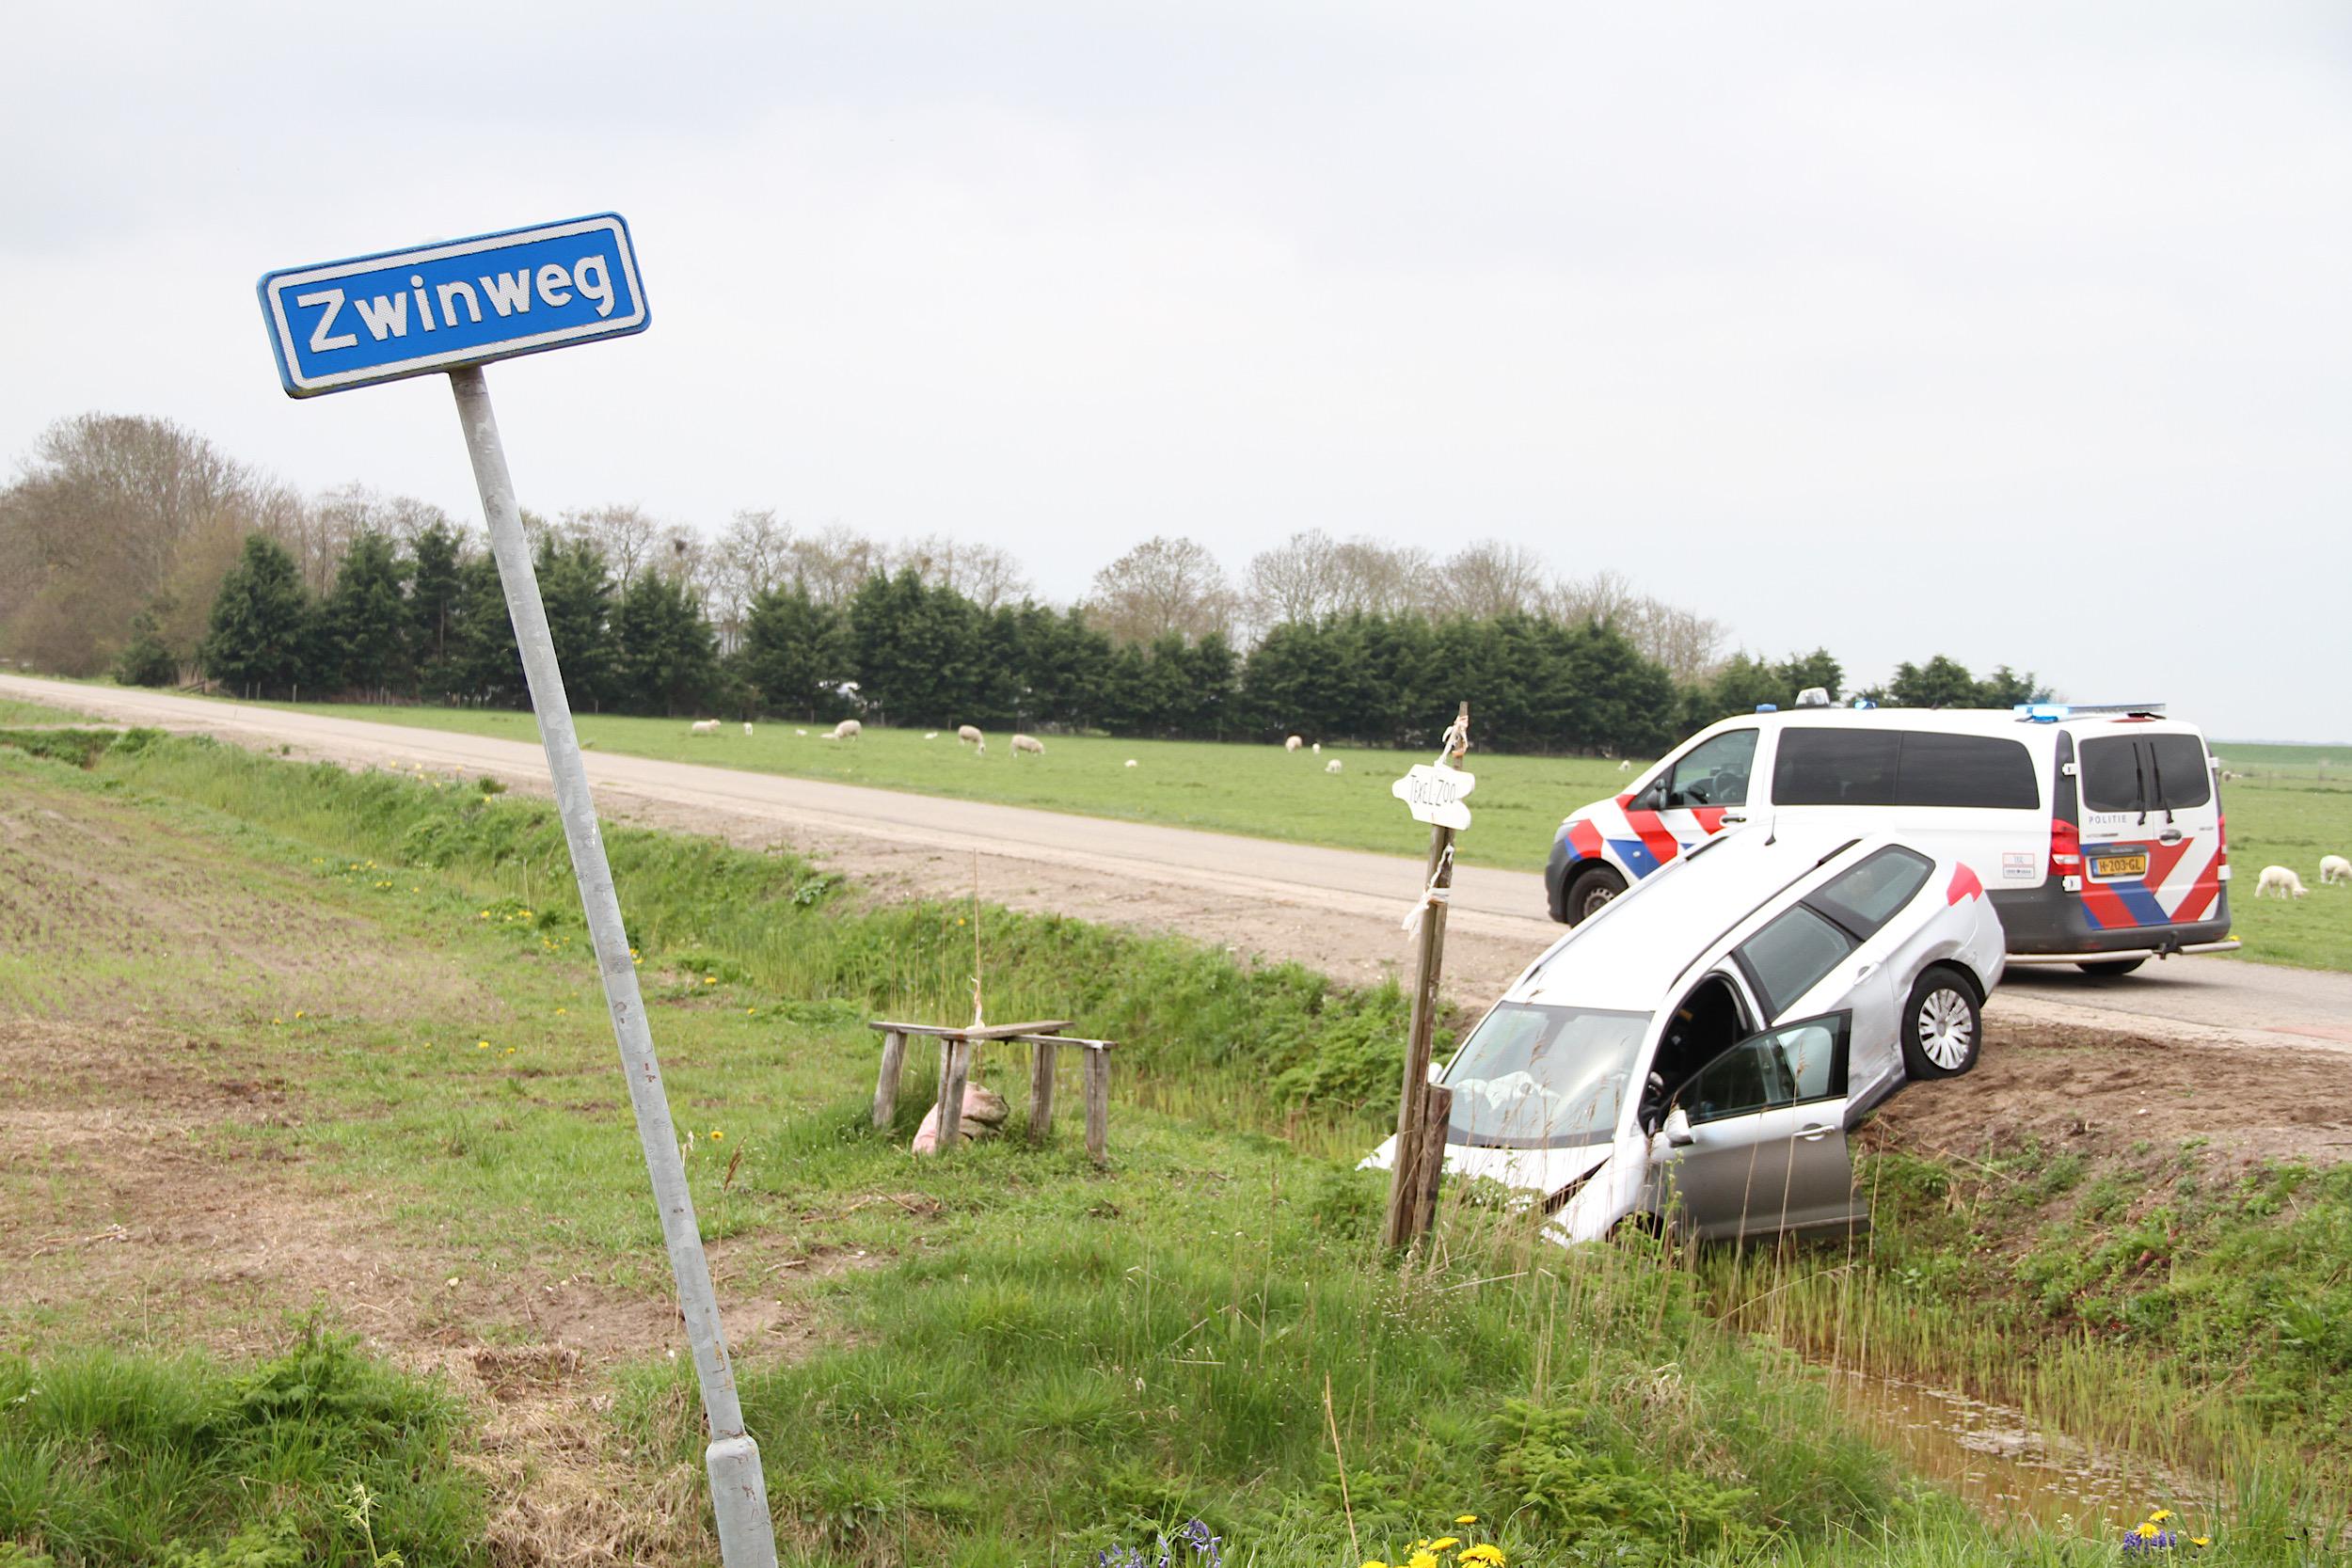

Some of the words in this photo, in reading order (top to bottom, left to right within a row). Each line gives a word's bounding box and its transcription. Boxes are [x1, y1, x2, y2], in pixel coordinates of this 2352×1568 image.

[296, 254, 616, 353] Zwinweg
[2088, 815, 2127, 825] POLITIE
[2098, 858, 2141, 873] H-203-GL
